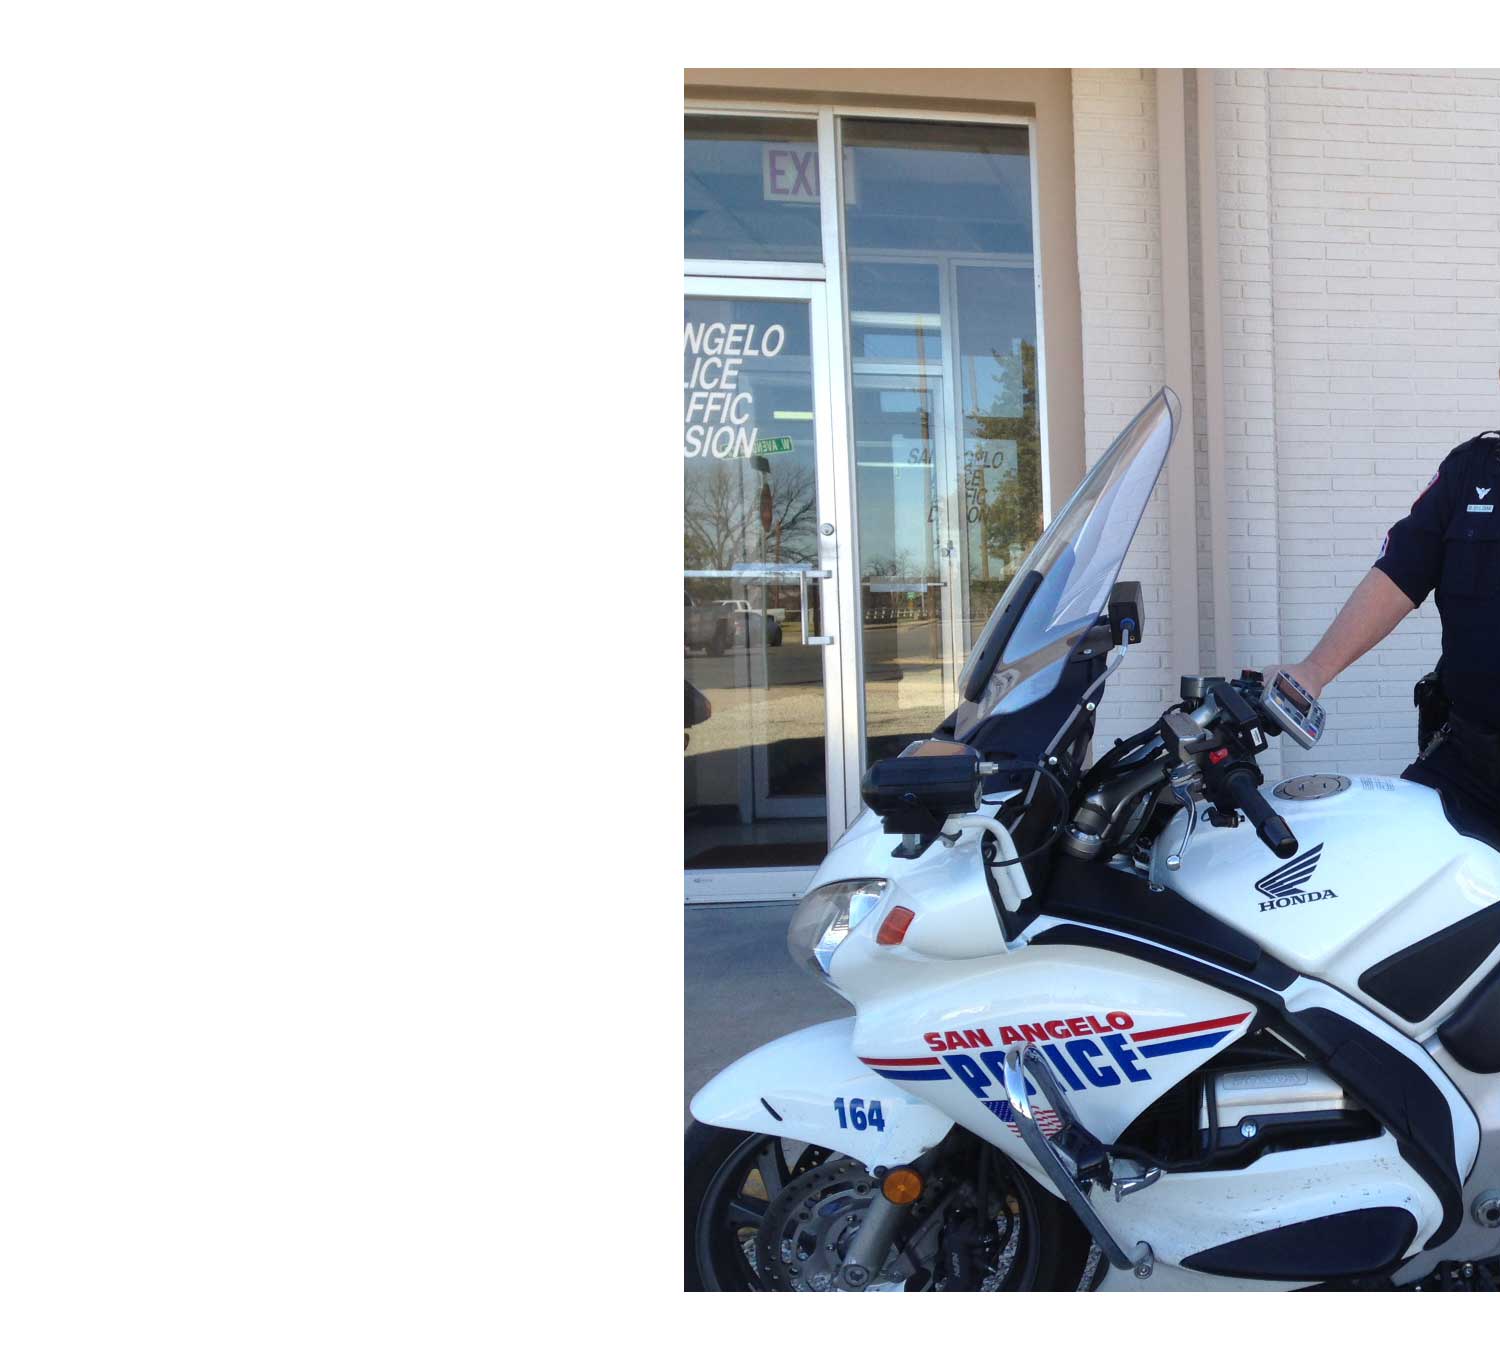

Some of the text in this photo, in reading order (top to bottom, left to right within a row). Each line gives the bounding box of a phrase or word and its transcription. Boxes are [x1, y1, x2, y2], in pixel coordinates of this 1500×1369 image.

[769, 150, 824, 197] EXI
[684, 322, 785, 357] NGELO
[685, 391, 753, 425] FFIC
[684, 425, 759, 458] SION
[1258, 889, 1339, 912] HONDA
[923, 1010, 1135, 1052] SAN ANGELO
[943, 1033, 1153, 1099] POICE
[834, 1097, 885, 1132] 164
